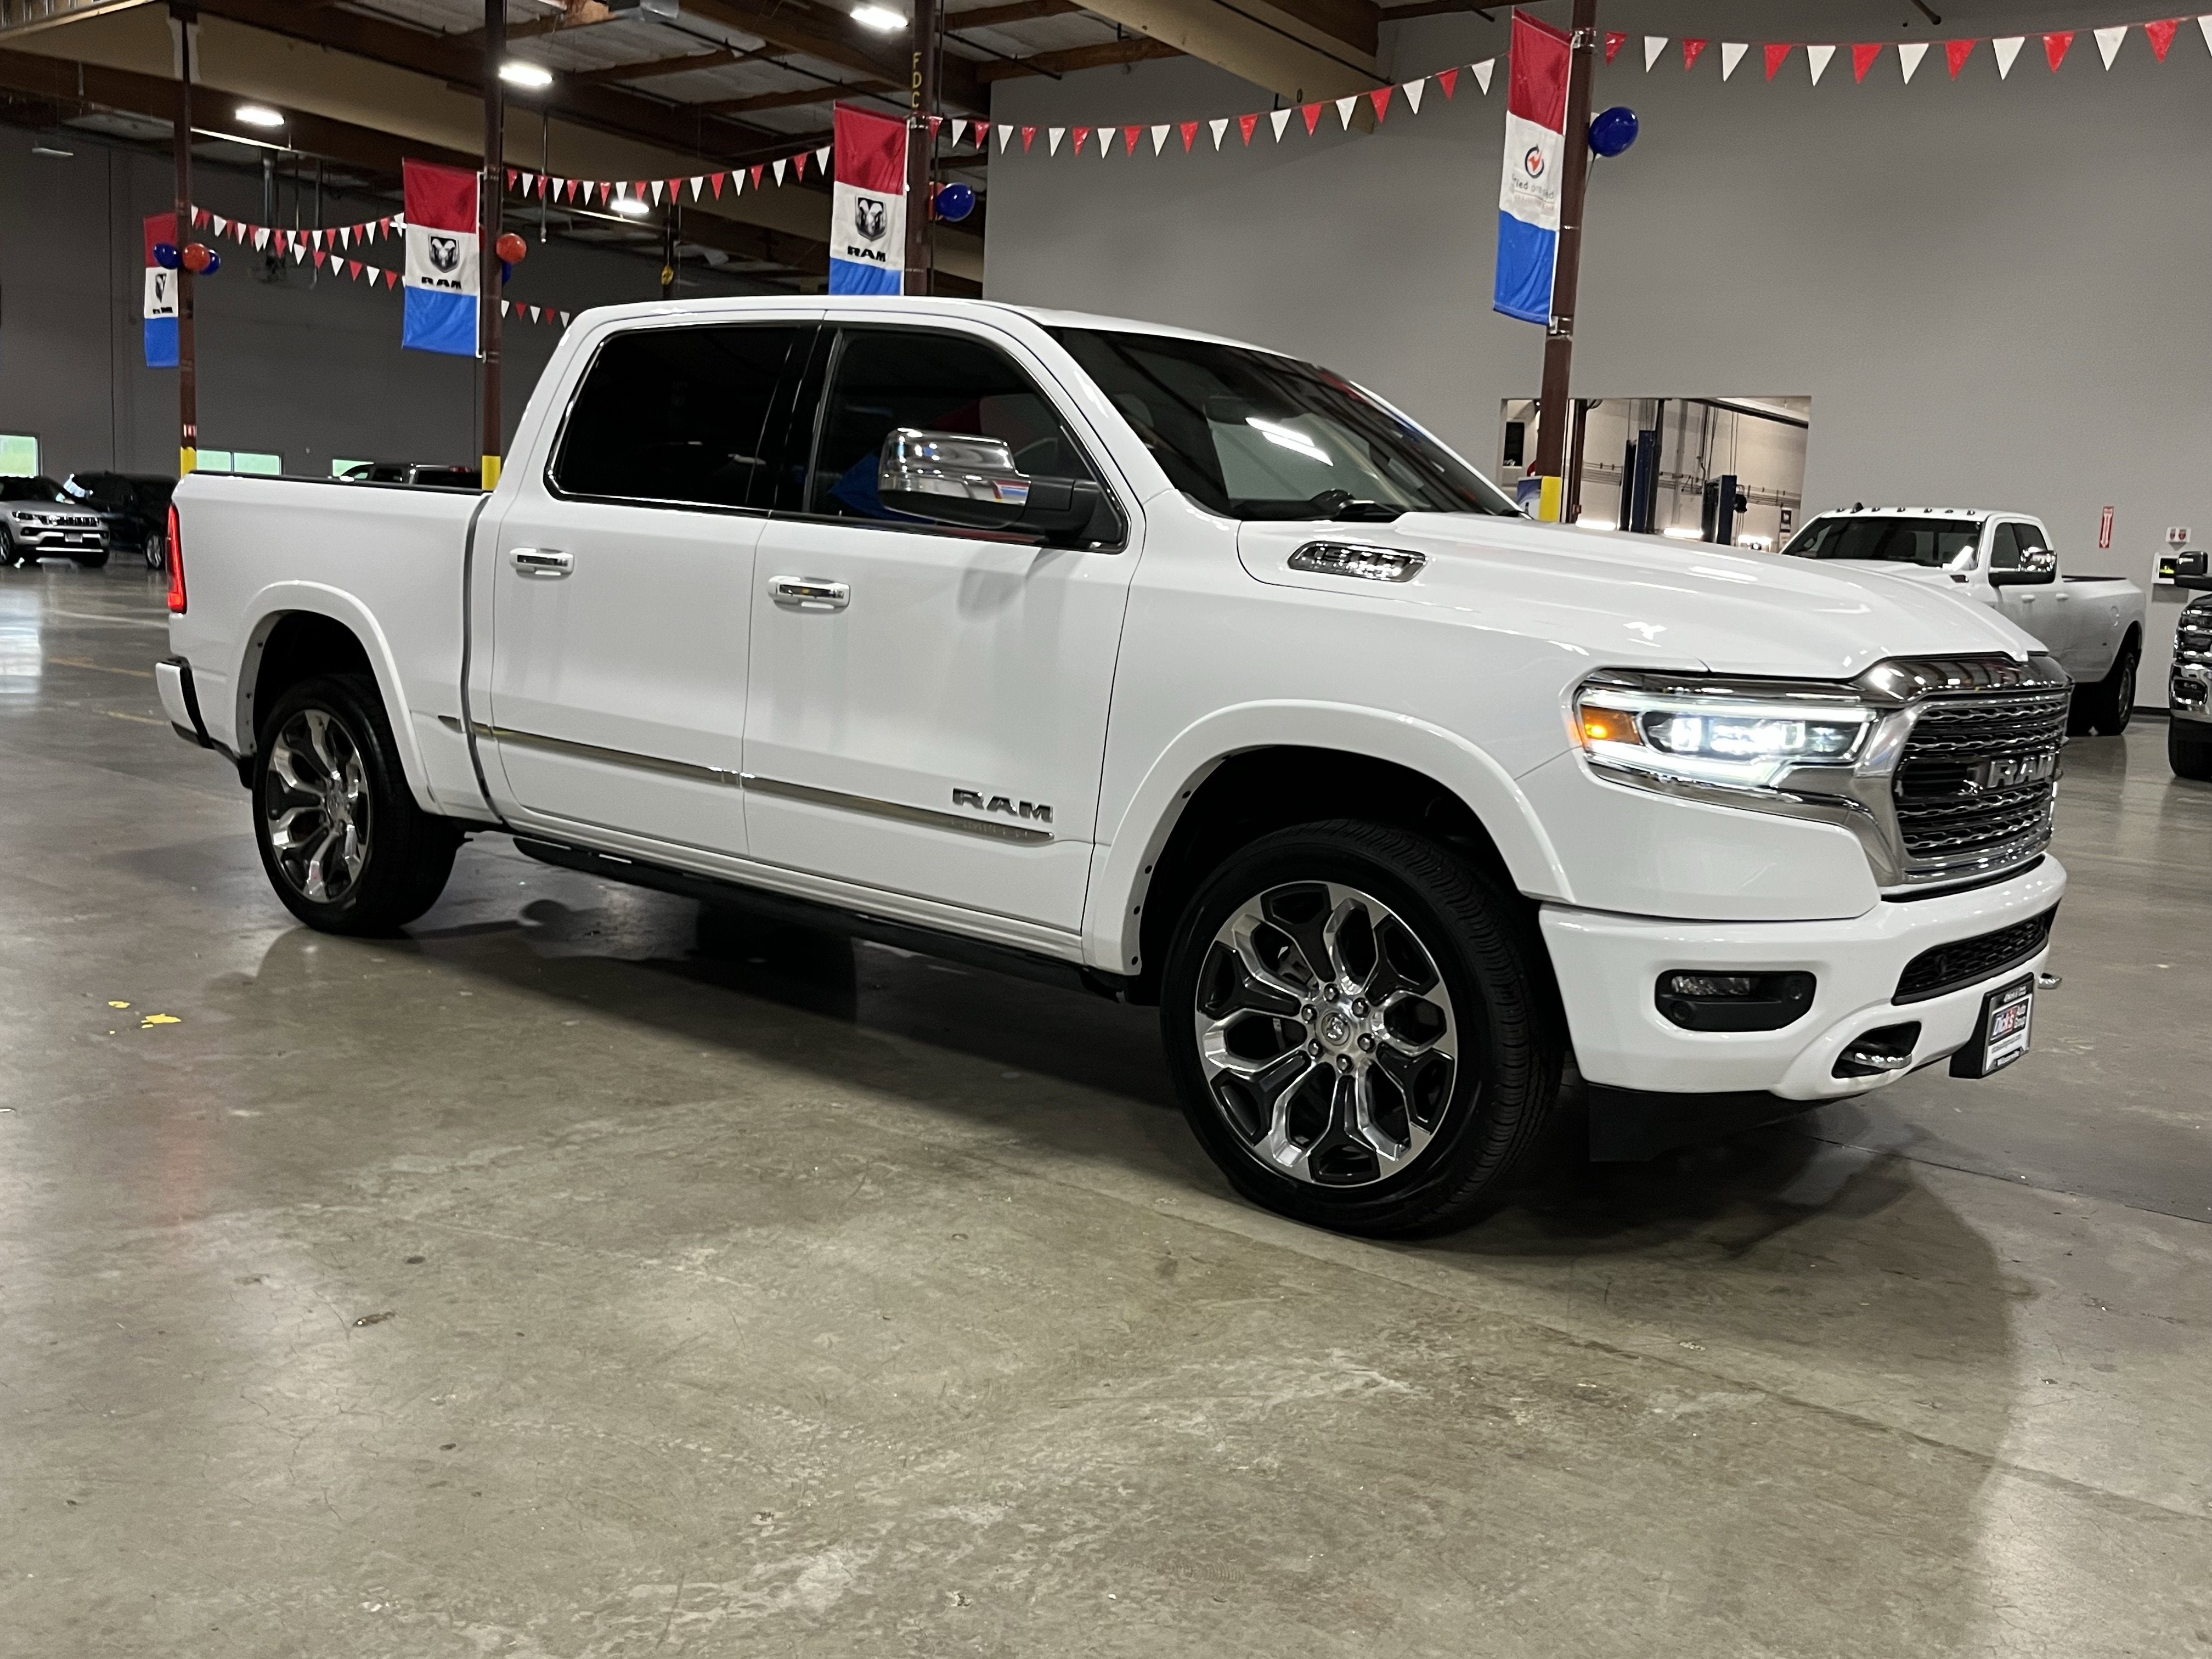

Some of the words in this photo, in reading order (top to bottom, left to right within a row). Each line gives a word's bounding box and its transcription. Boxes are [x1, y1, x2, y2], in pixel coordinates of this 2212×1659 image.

[912, 52, 922, 108] FDC
[847, 245, 886, 262] RAM
[421, 276, 462, 290] RAM
[1987, 752, 2056, 788] RAM
[952, 787, 1053, 823] RAM
